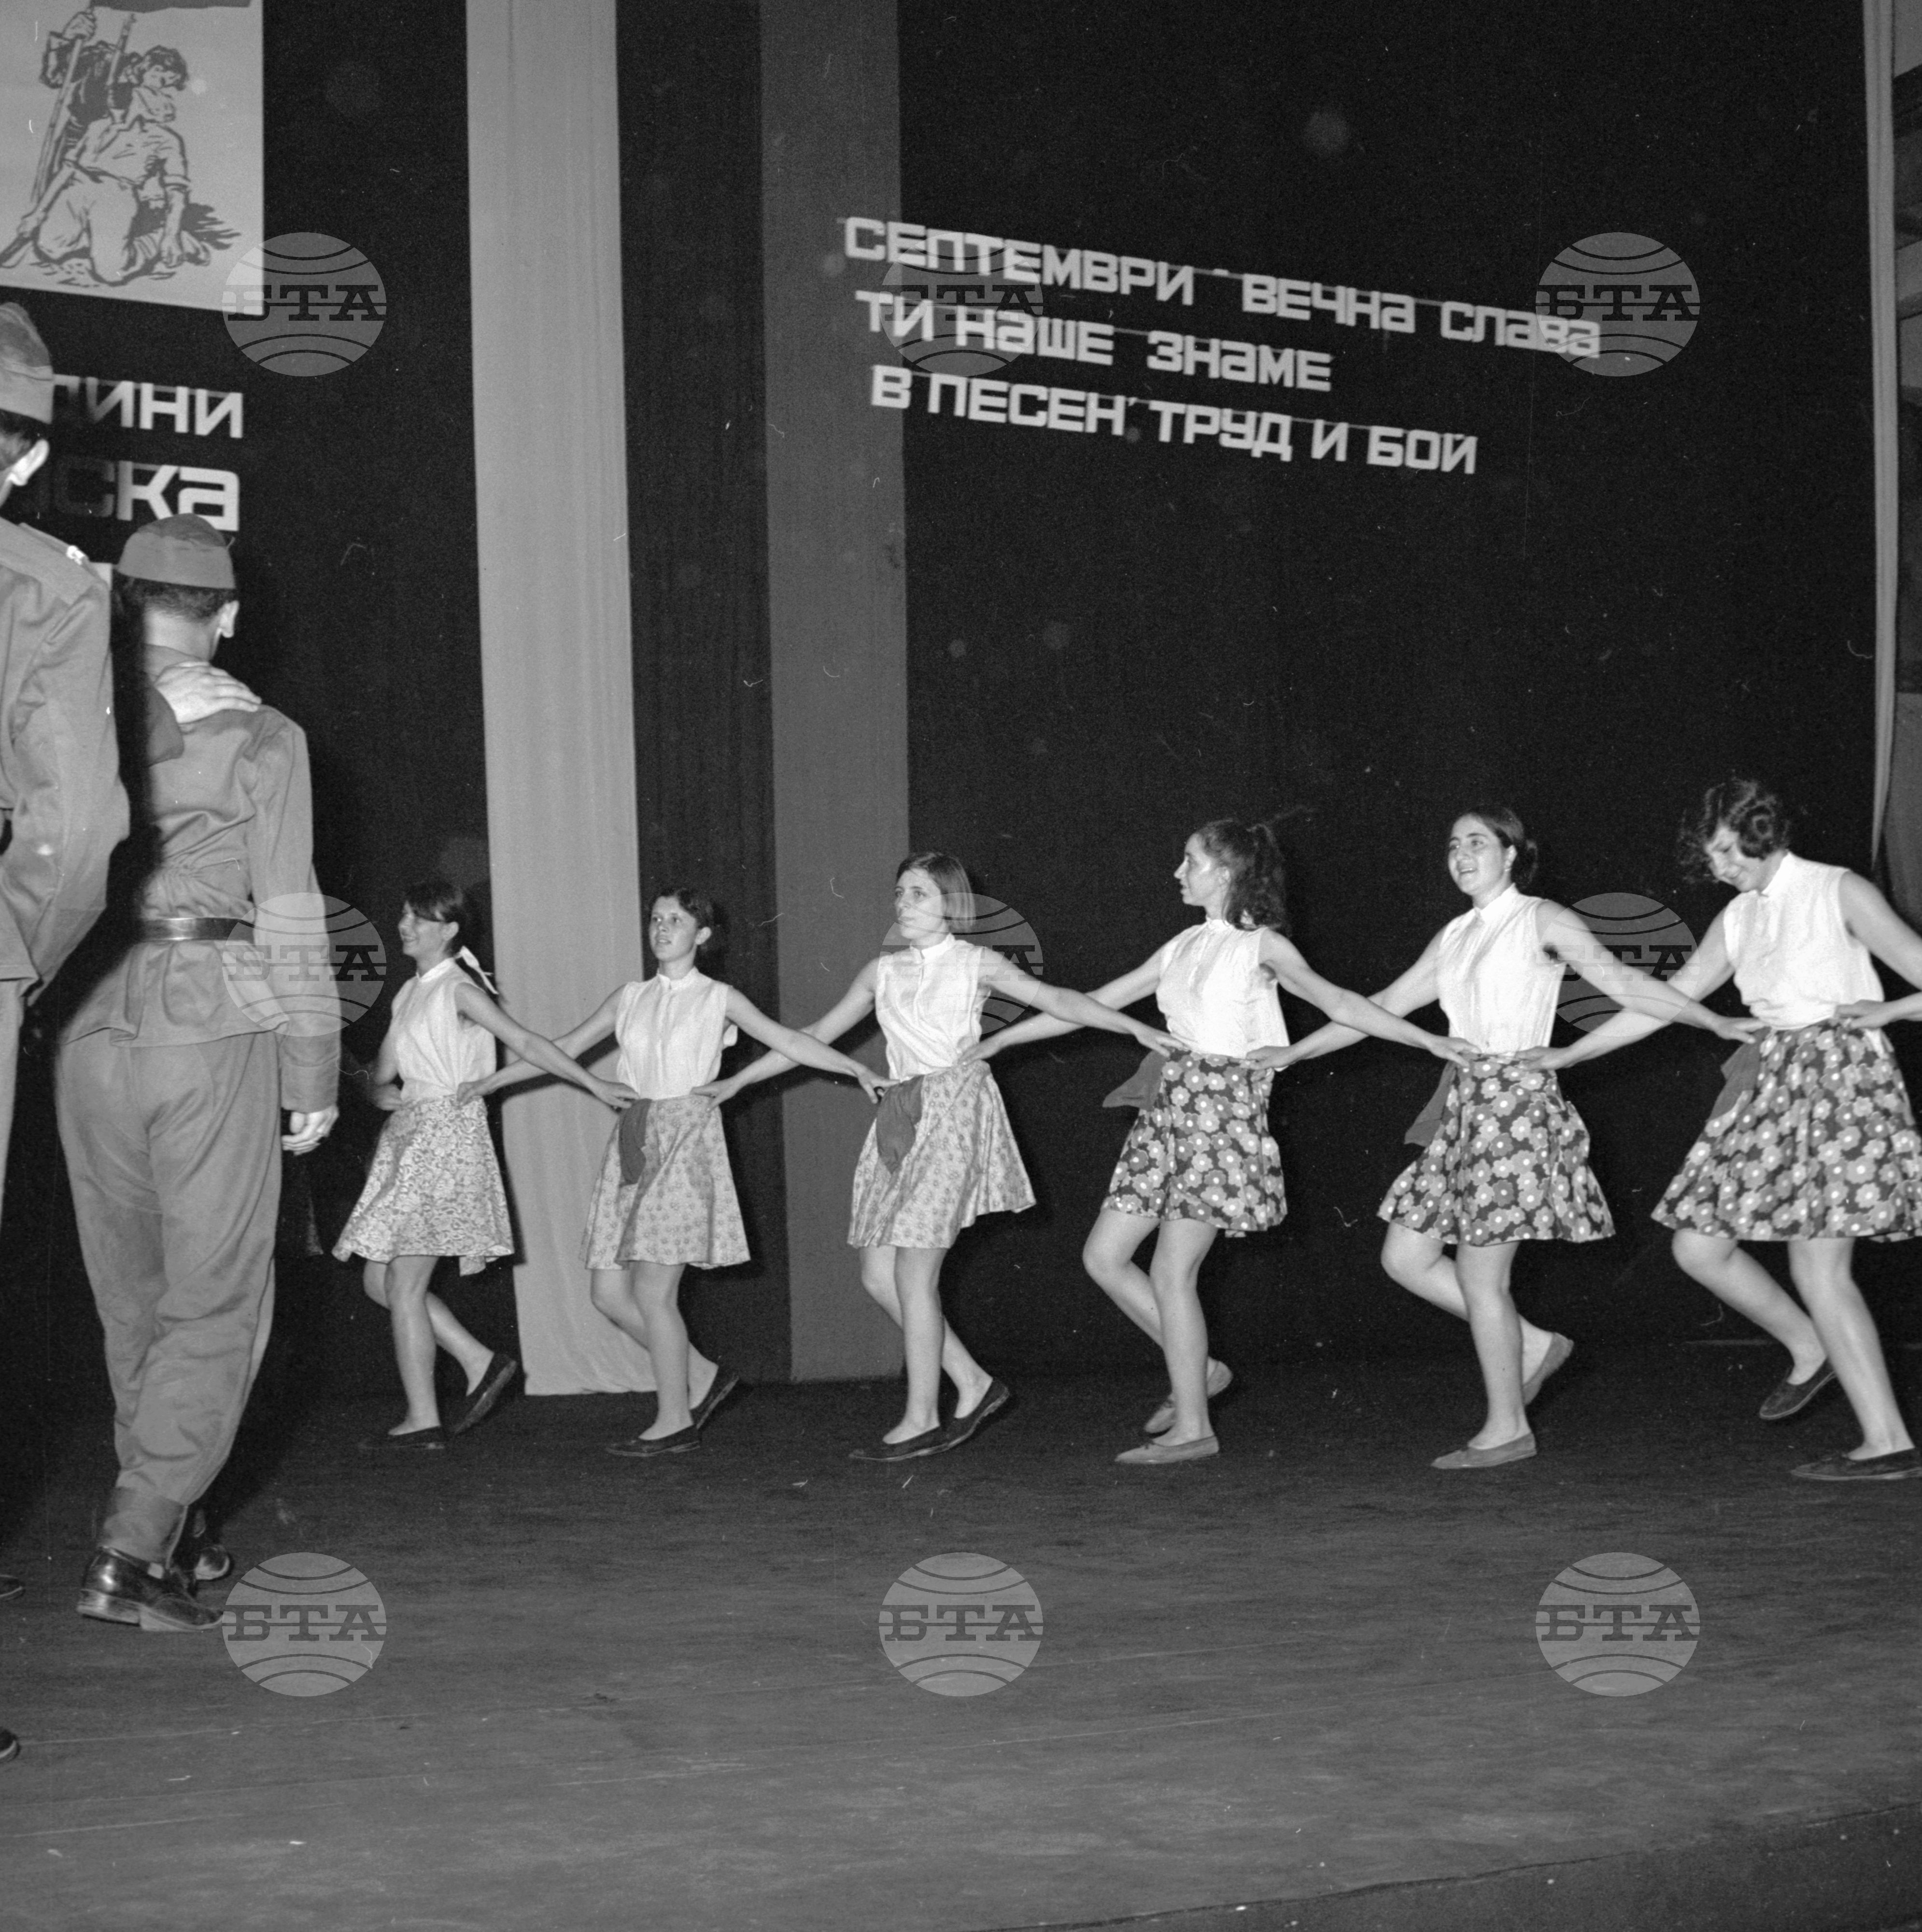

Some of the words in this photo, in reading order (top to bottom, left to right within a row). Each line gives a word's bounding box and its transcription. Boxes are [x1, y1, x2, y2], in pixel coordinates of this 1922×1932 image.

[845, 217, 1194, 305] СЕПТЕМВРИ
[855, 290, 934, 341] ТИ
[871, 364, 913, 409] В
[1148, 398, 1293, 462] ТРУД
[1311, 418, 1349, 462] И
[1367, 425, 1478, 475] БОЙ
